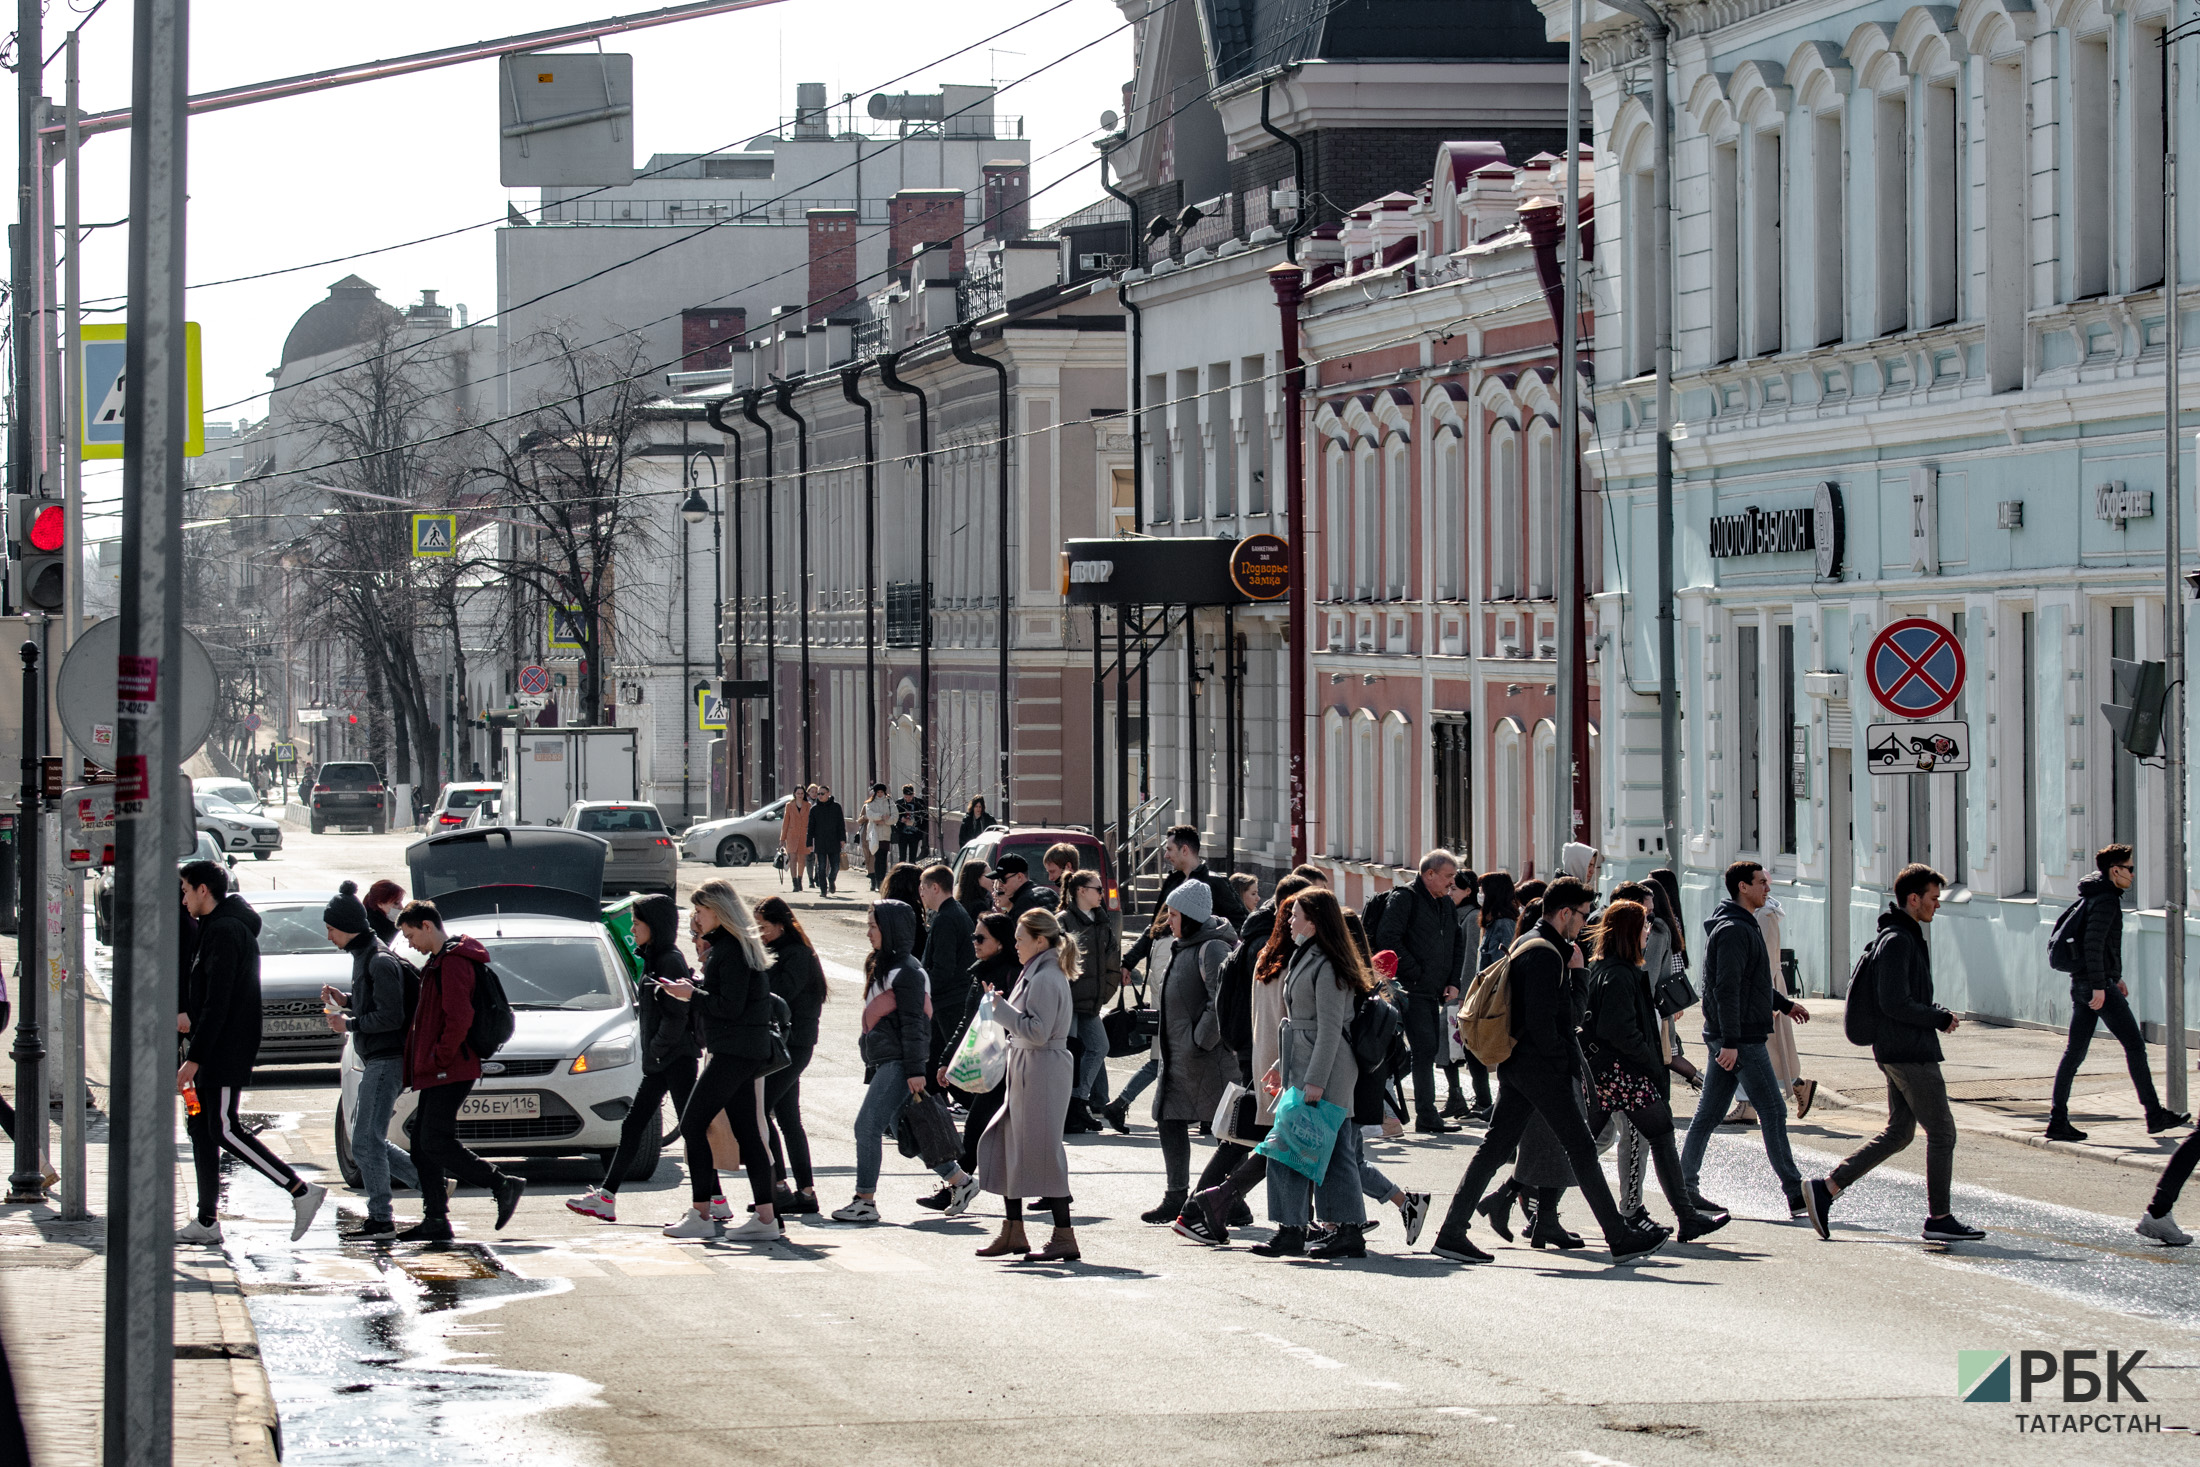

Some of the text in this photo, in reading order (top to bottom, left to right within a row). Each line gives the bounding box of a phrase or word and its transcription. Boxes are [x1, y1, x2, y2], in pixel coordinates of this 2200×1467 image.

[2095, 479, 2144, 531] Кофеин
[1710, 506, 1806, 558] ОЛОТОЙ БАБИЛОН
[1241, 561, 1289, 576] Подворье
[513, 1097, 534, 1108] 116
